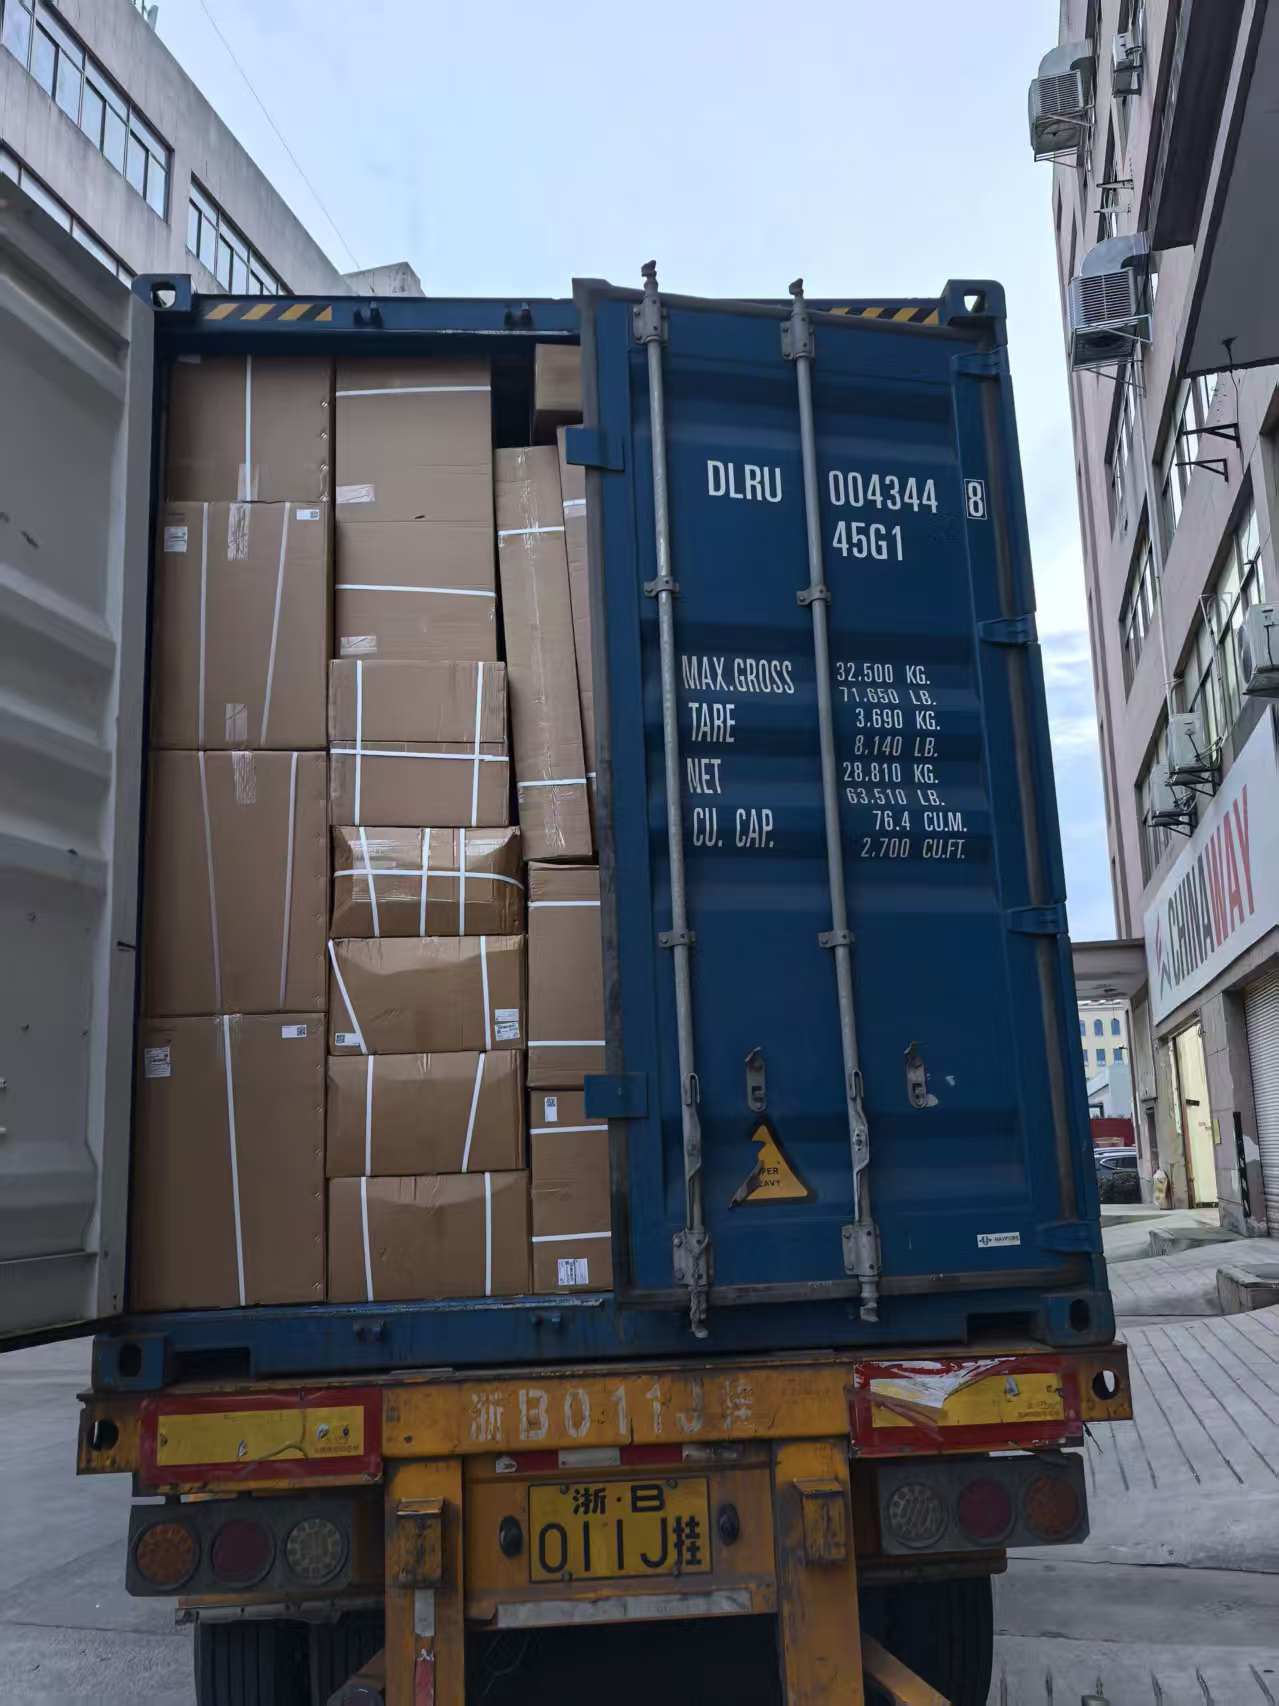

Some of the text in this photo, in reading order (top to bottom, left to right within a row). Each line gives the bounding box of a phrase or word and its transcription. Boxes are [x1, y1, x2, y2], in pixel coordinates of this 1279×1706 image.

[707, 459, 984, 517] DLRU 004344 8
[832, 520, 903, 561] 45G1
[681, 655, 795, 694] MAX.GROSS
[905, 664, 931, 685] KG.
[909, 689, 937, 706] LB.
[688, 702, 736, 743] TARE
[915, 710, 941, 731] KG.
[913, 736, 939, 757] LB.
[686, 758, 722, 794] NET
[913, 763, 939, 784] KG.
[917, 788, 945, 806] LB.
[693, 807, 723, 847] CU.
[735, 808, 775, 848] CAP.
[872, 810, 911, 831] 76.4
[1168, 784, 1255, 986] CHINAWAY
